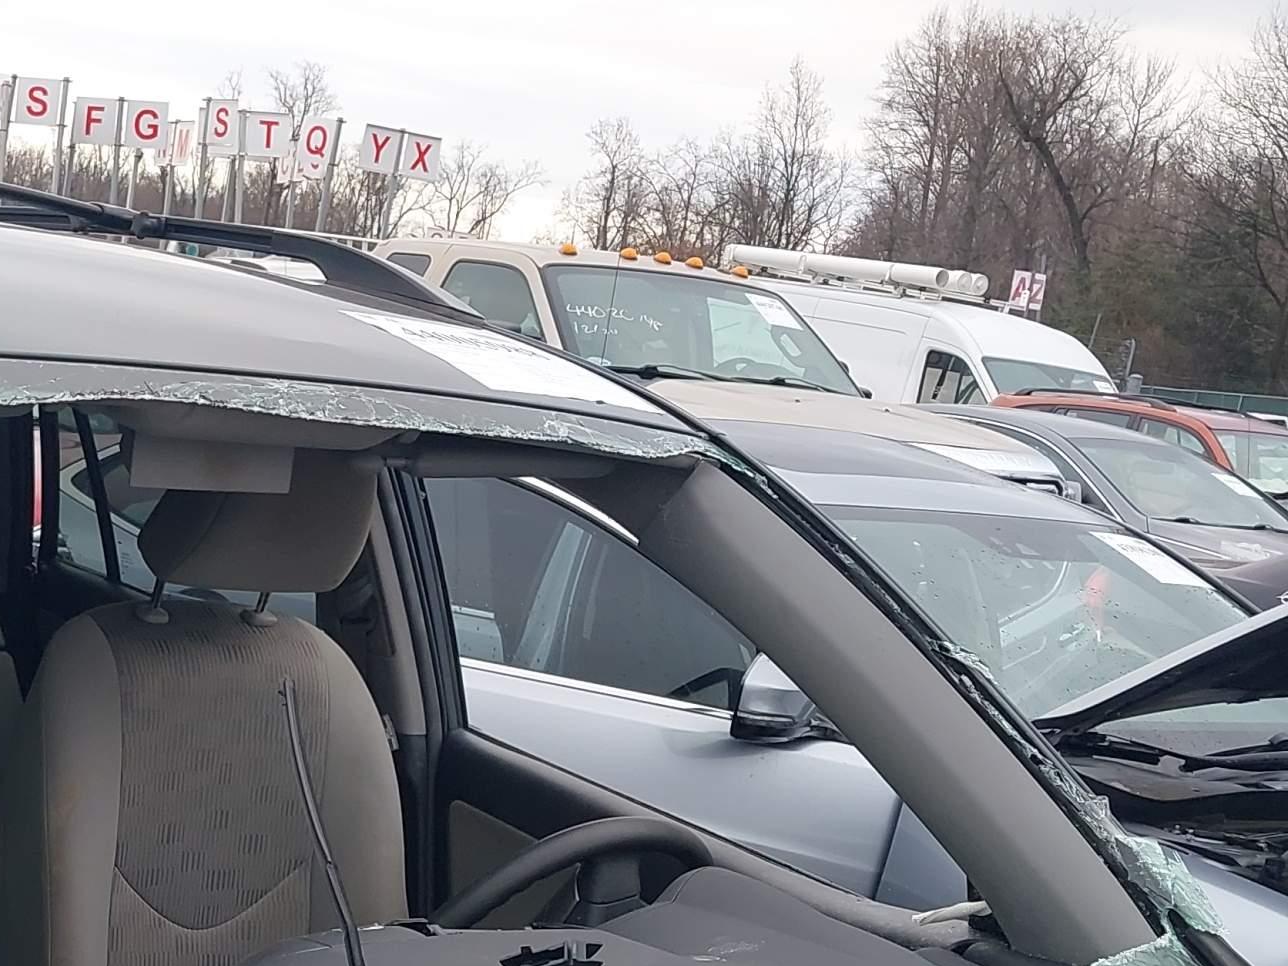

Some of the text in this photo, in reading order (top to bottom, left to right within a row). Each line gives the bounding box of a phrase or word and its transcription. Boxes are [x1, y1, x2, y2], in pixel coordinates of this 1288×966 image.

[26, 86, 49, 117] S
[84, 106, 105, 136] F
[134, 109, 159, 140] G
[214, 107, 229, 138] S
[259, 120, 280, 148] T
[306, 125, 327, 158] Q
[372, 132, 391, 164] Y
[410, 142, 432, 173] X
